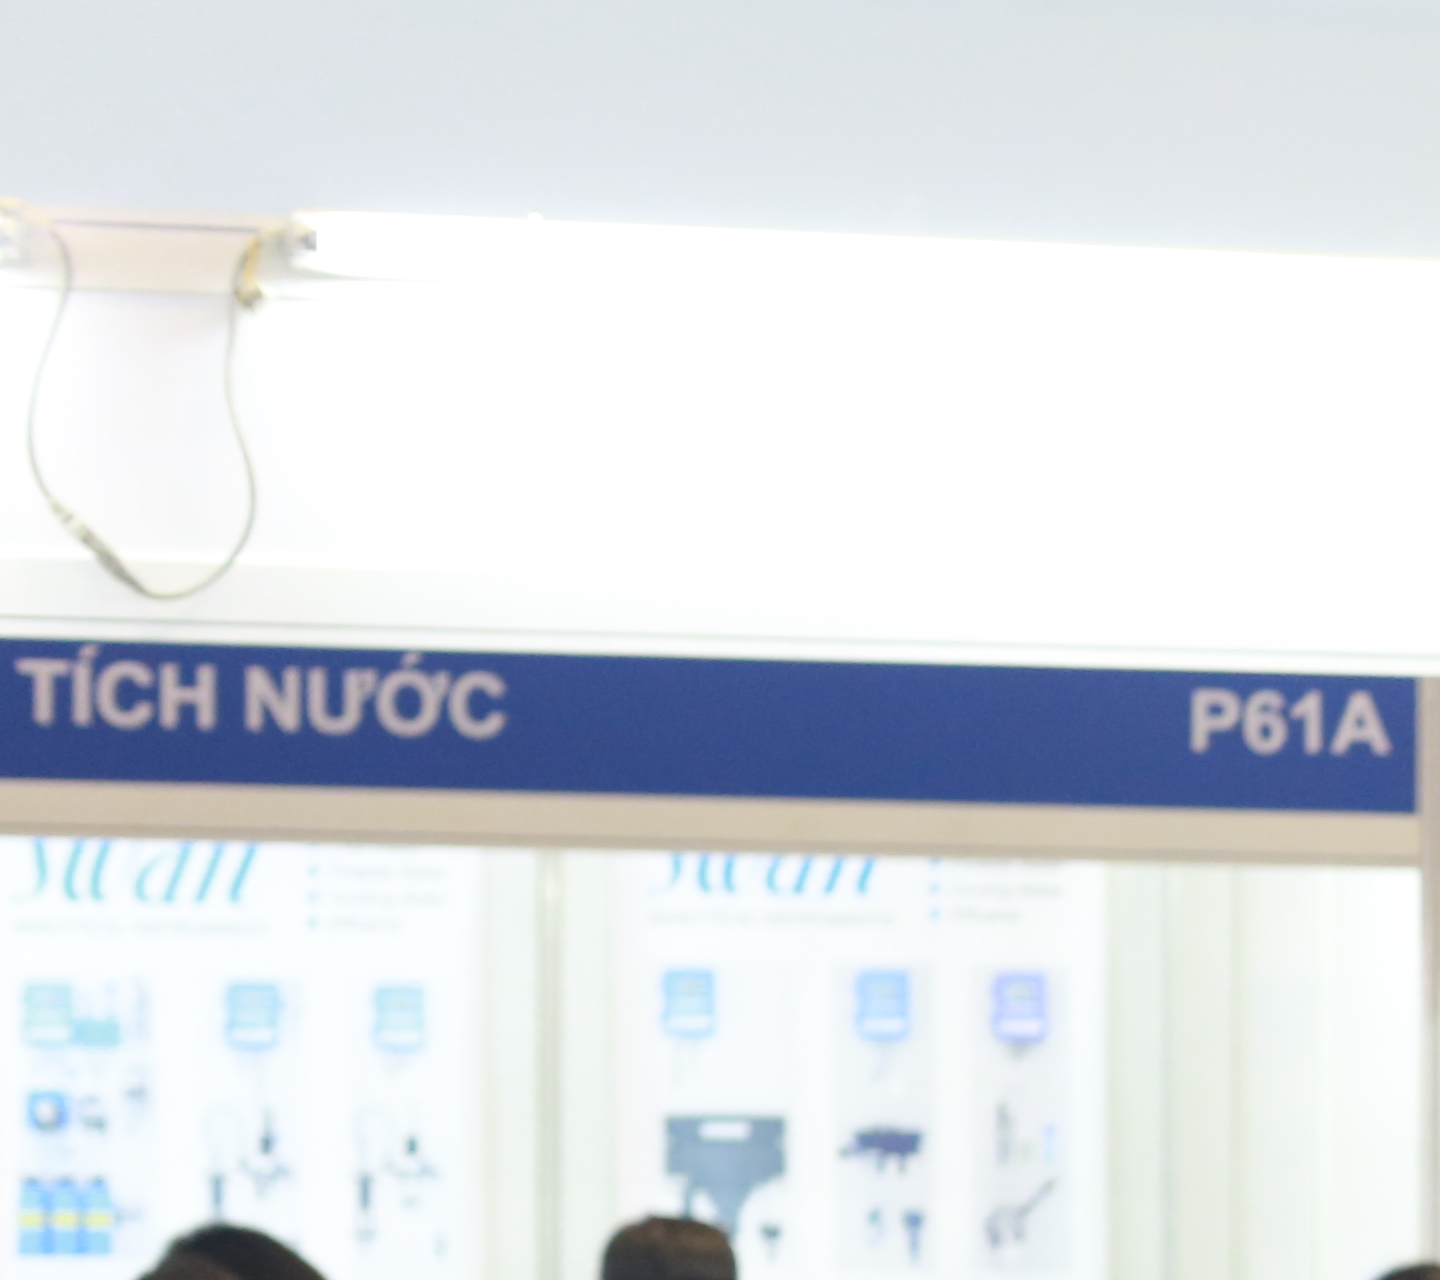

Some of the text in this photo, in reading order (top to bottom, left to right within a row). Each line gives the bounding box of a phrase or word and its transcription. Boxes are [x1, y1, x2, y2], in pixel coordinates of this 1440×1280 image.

[15, 643, 508, 741] TÍCH NƯỚC
[1190, 687, 1392, 757] P61A
